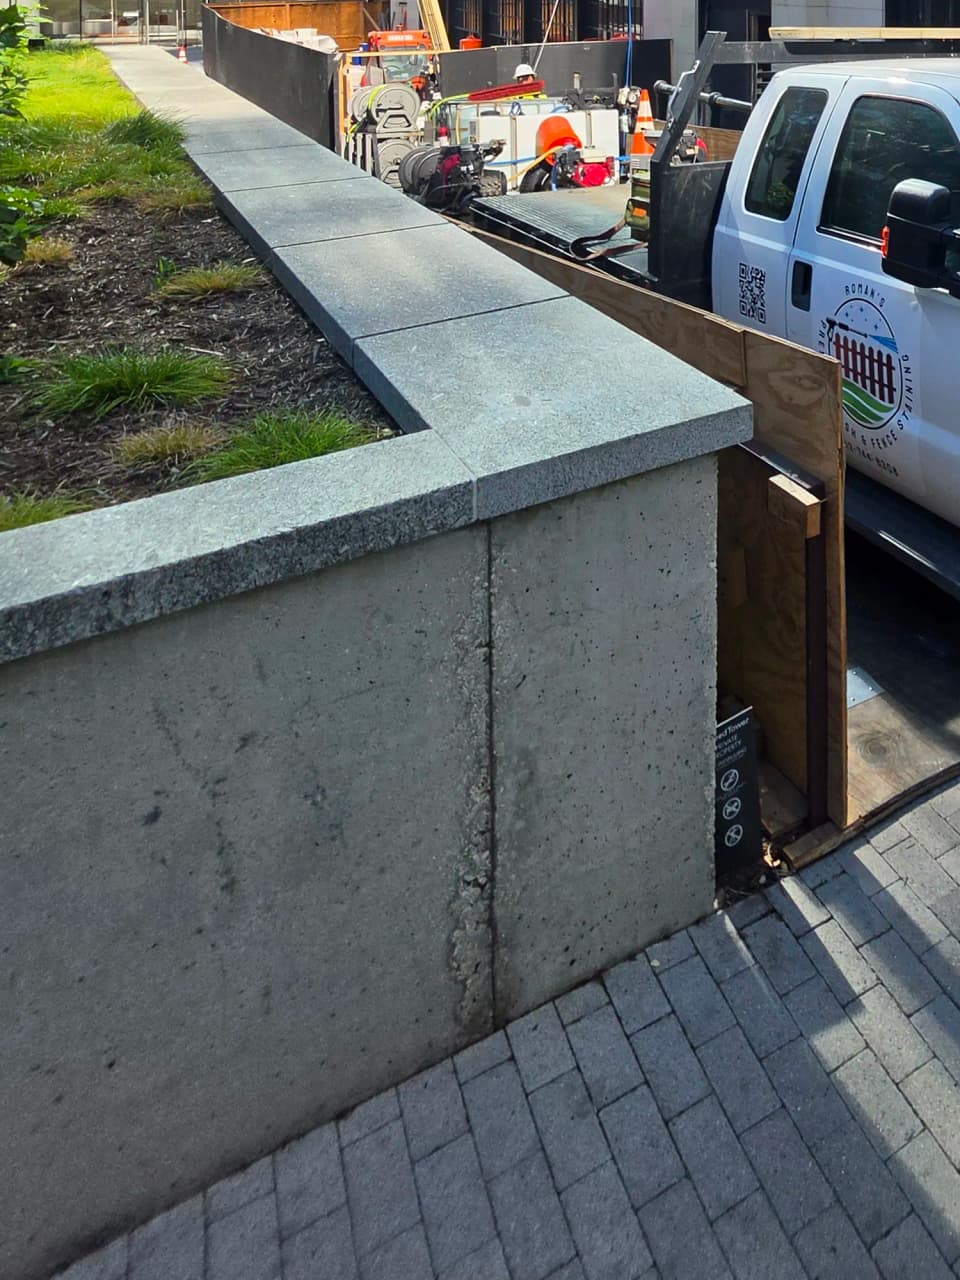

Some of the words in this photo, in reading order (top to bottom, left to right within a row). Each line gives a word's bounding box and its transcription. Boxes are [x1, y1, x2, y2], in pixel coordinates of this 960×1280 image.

[844, 282, 886, 308] ROMAN'S
[870, 429, 898, 450] FENCE
[897, 353, 913, 431] STAINING
